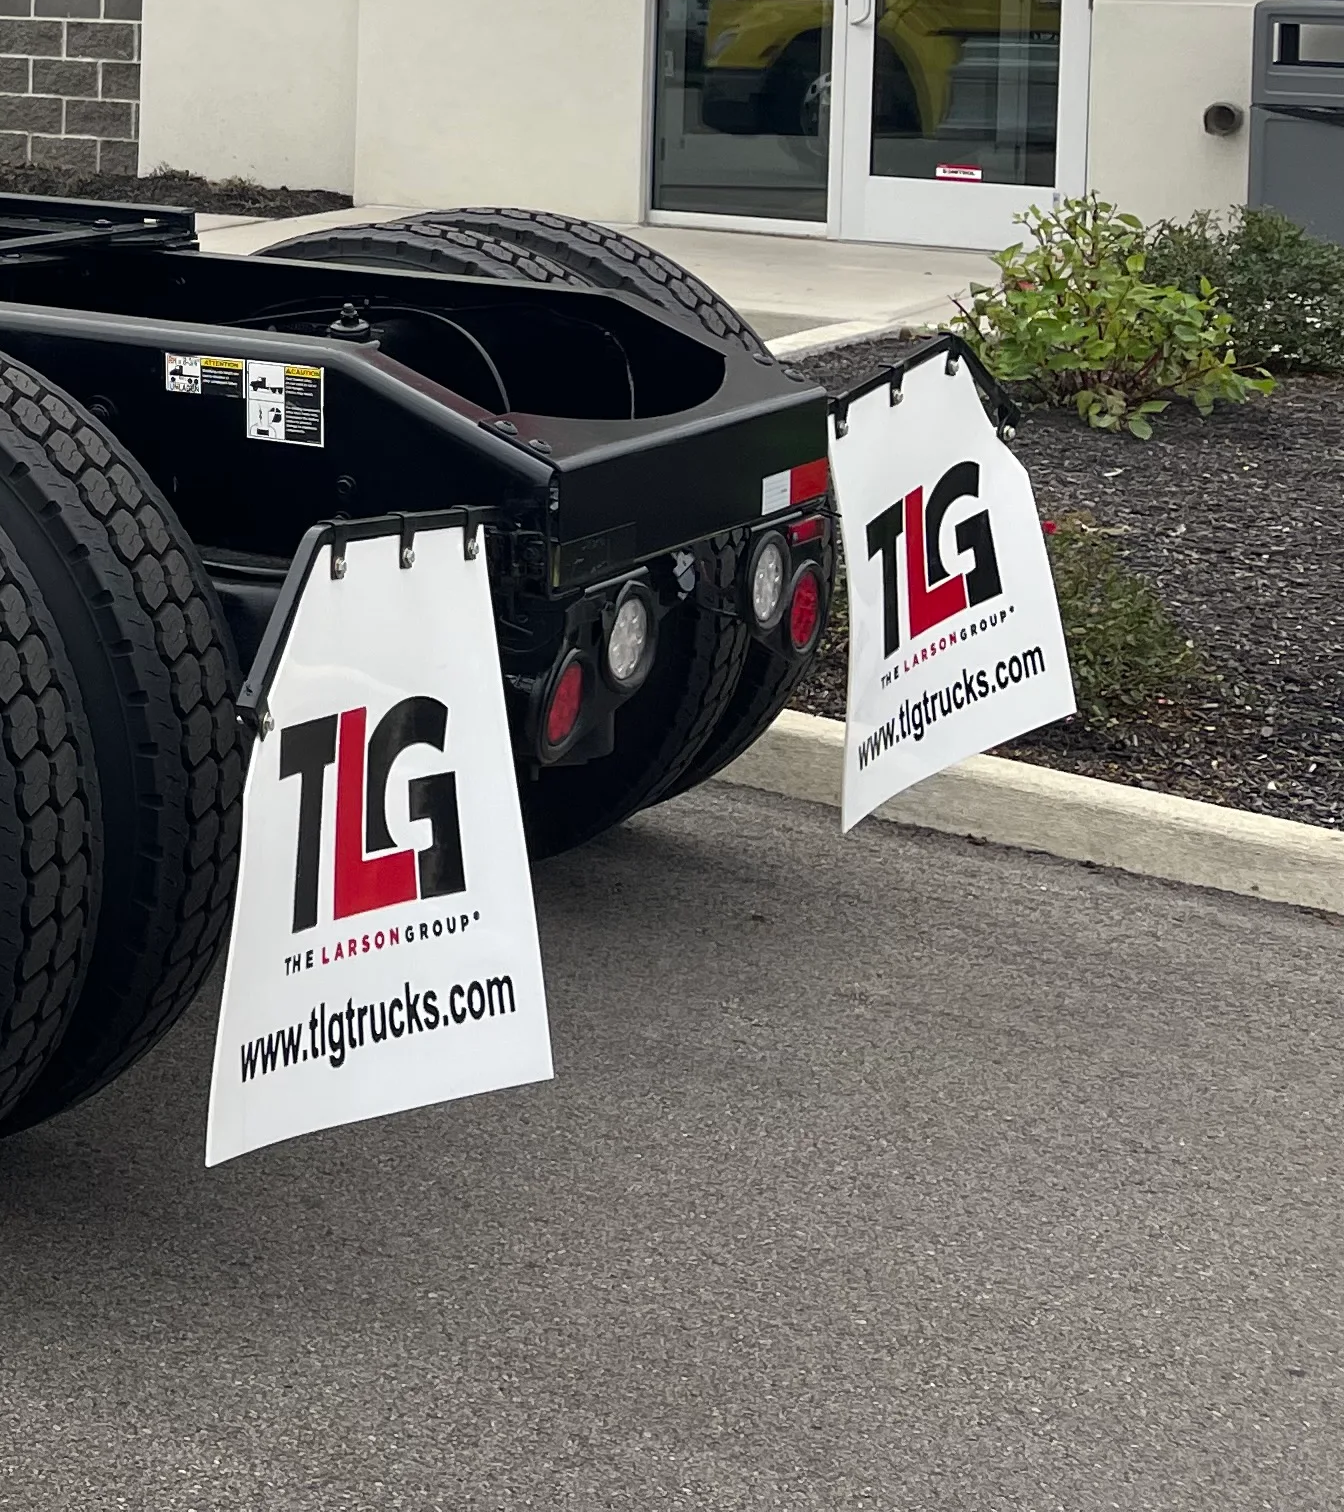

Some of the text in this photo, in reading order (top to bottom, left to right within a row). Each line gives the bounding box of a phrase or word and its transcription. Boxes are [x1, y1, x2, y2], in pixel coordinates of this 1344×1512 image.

[204, 359, 239, 368] ATTENTION
[291, 368, 320, 377] CAUTION
[866, 460, 1004, 661] TLG
[858, 645, 1046, 771] www.tlgtrucks.com
[880, 665, 900, 690] THE
[278, 695, 467, 934] TLG
[284, 949, 315, 977] THE
[240, 972, 517, 1083] www.tlgtrucks.com
